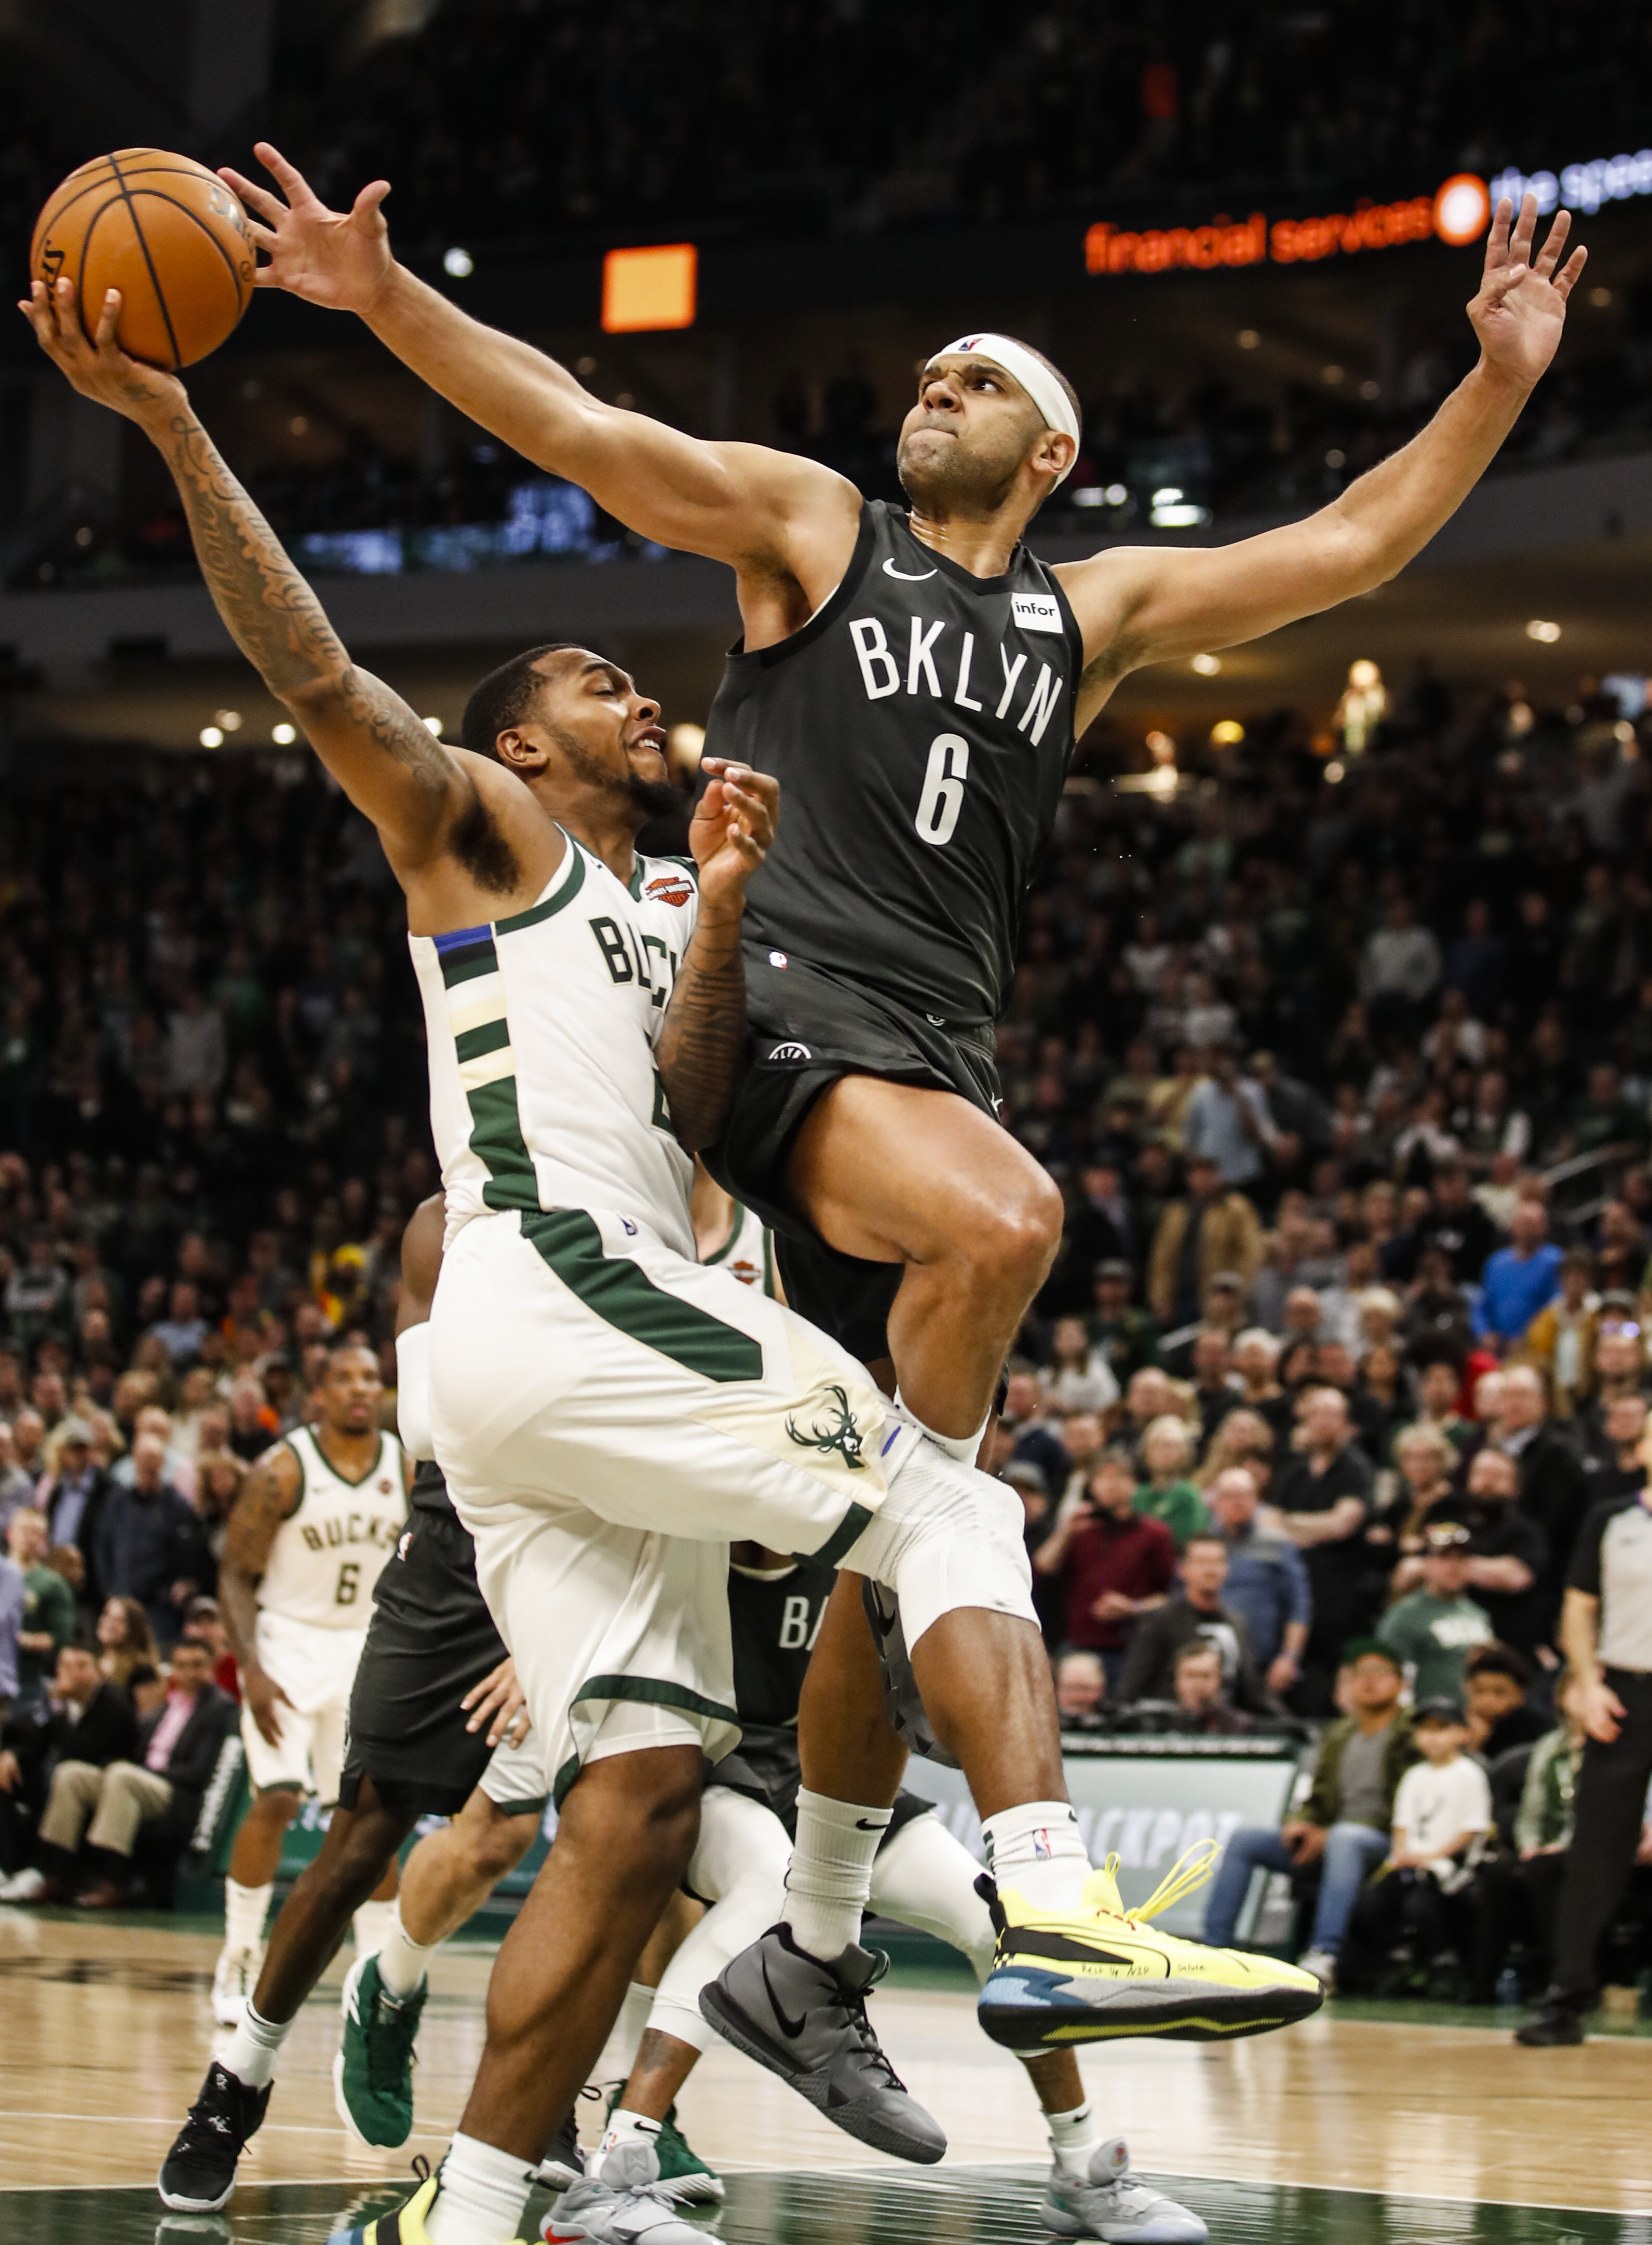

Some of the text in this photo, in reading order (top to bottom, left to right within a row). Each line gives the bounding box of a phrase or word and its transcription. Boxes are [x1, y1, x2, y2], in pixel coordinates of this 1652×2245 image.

[1084, 196, 1434, 274] financial services
[1015, 602, 1055, 617] infor
[849, 616, 1063, 747] BKLYN
[915, 733, 970, 846] 6
[335, 1563, 361, 1605] 6
